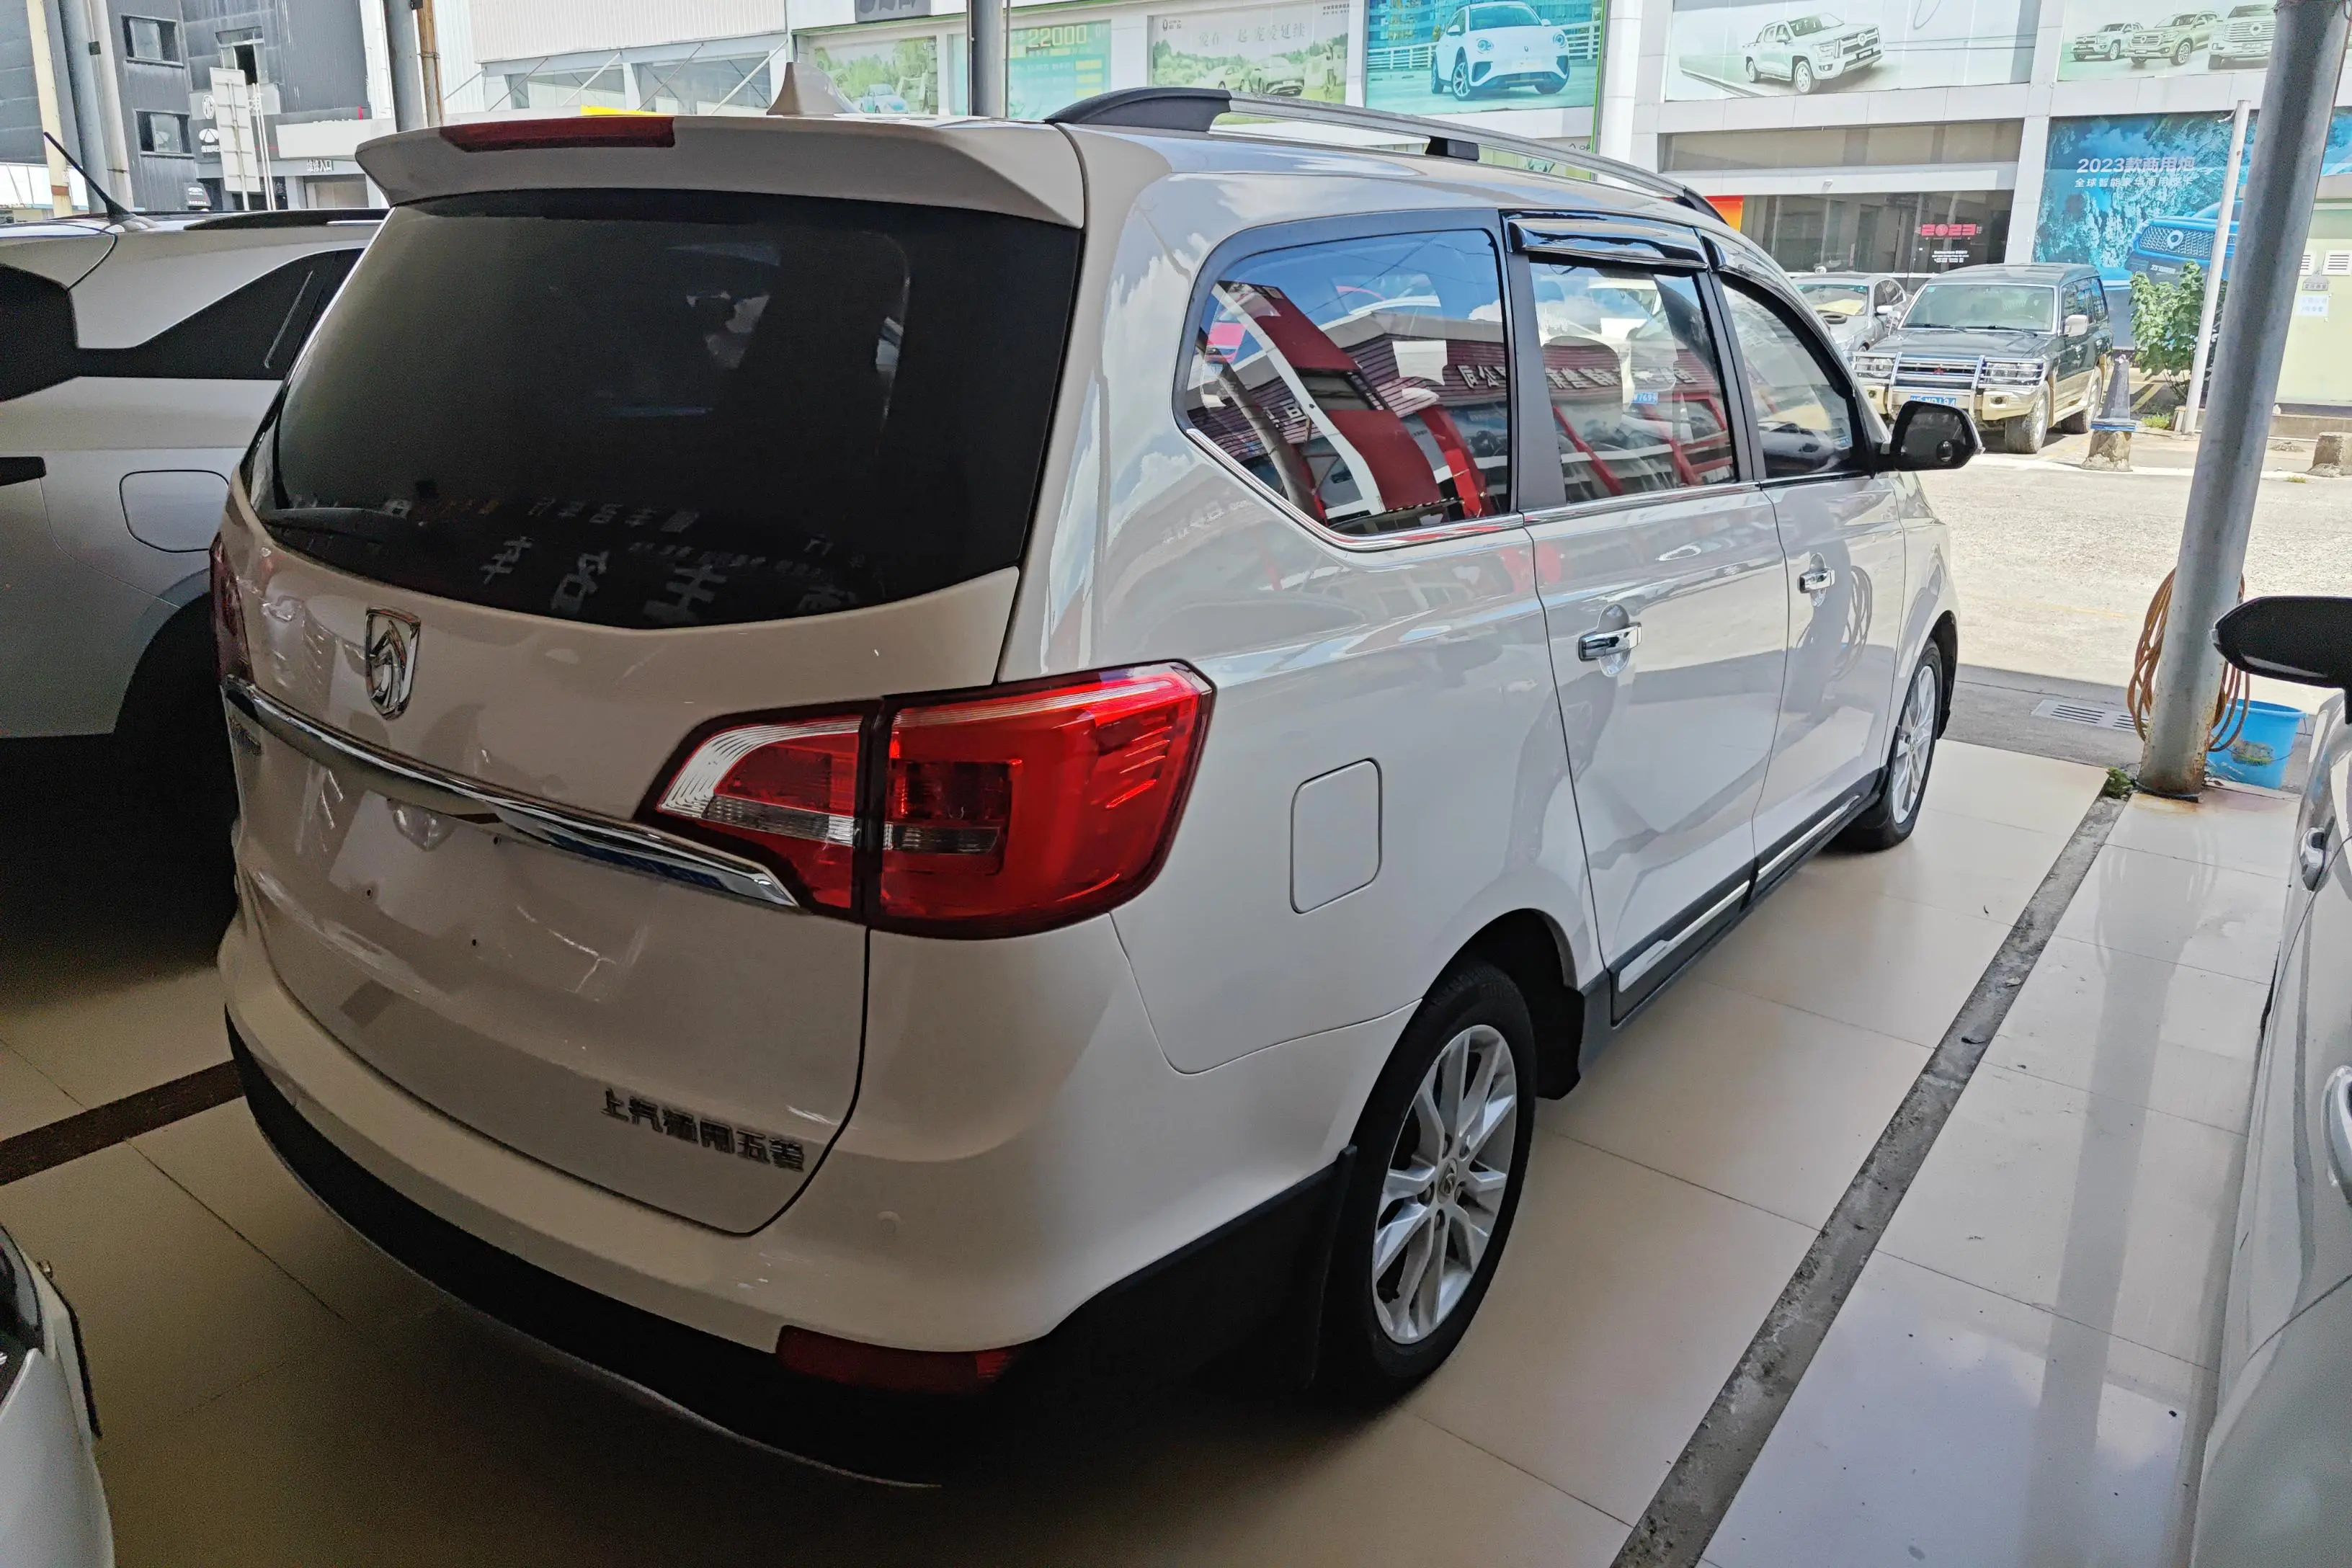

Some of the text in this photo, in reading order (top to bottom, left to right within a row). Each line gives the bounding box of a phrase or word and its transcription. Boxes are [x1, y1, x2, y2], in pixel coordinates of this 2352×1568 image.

[2076, 156, 2195, 174] 2023款商用炮
[600, 1087, 805, 1172] 上汽通用五菱
